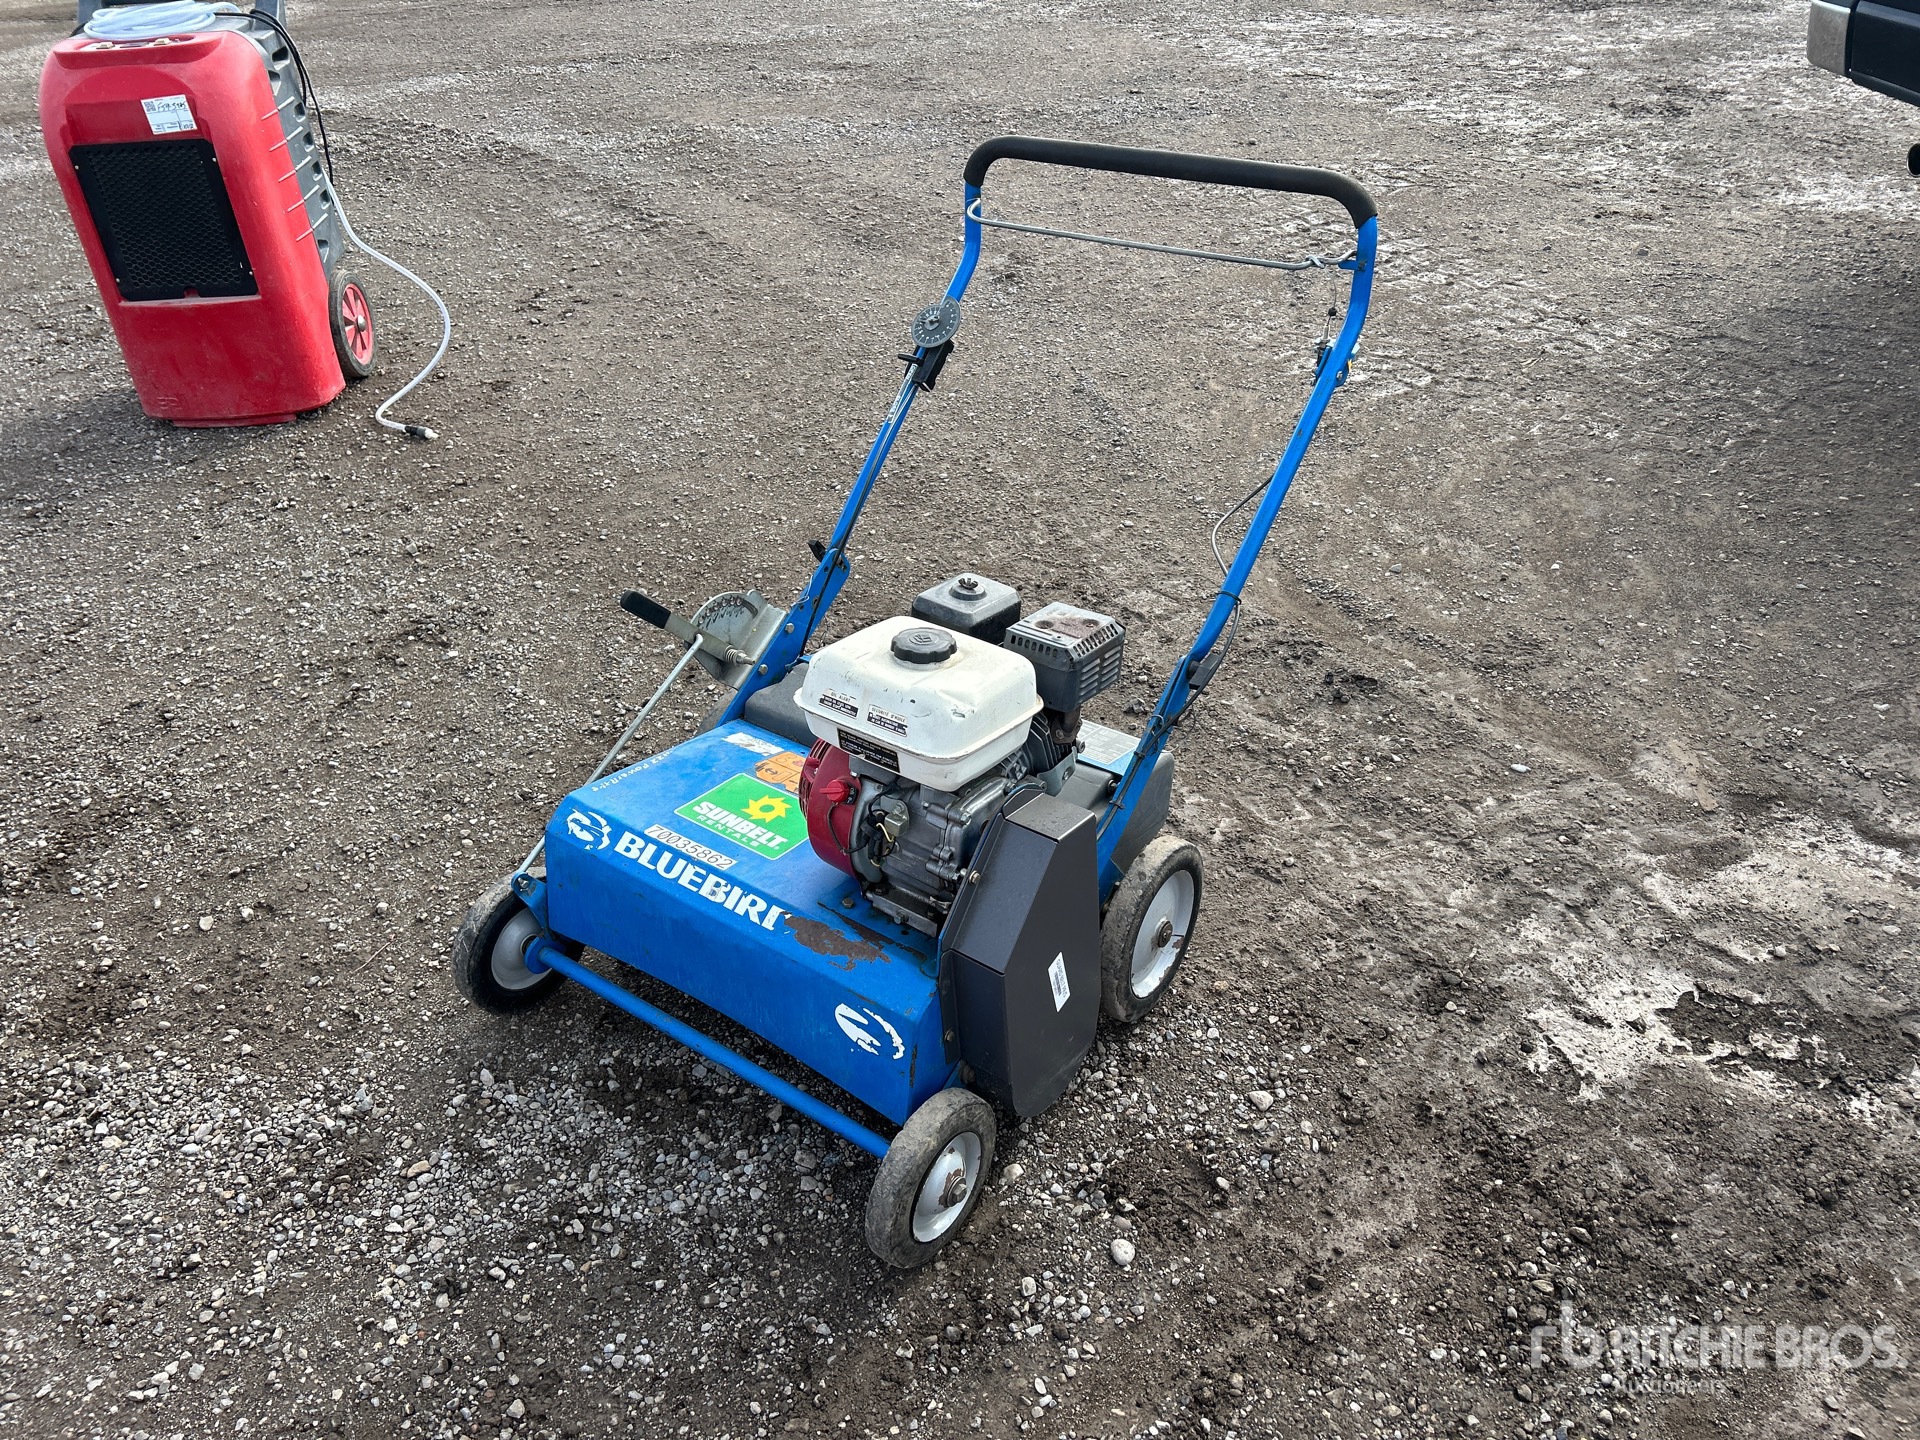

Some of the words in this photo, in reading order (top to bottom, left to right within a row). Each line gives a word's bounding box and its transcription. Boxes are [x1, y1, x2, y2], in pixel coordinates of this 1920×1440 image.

[647, 825, 734, 870] 70035862
[692, 801, 789, 849] SUNBELT
[696, 814, 760, 847] RENTALS
